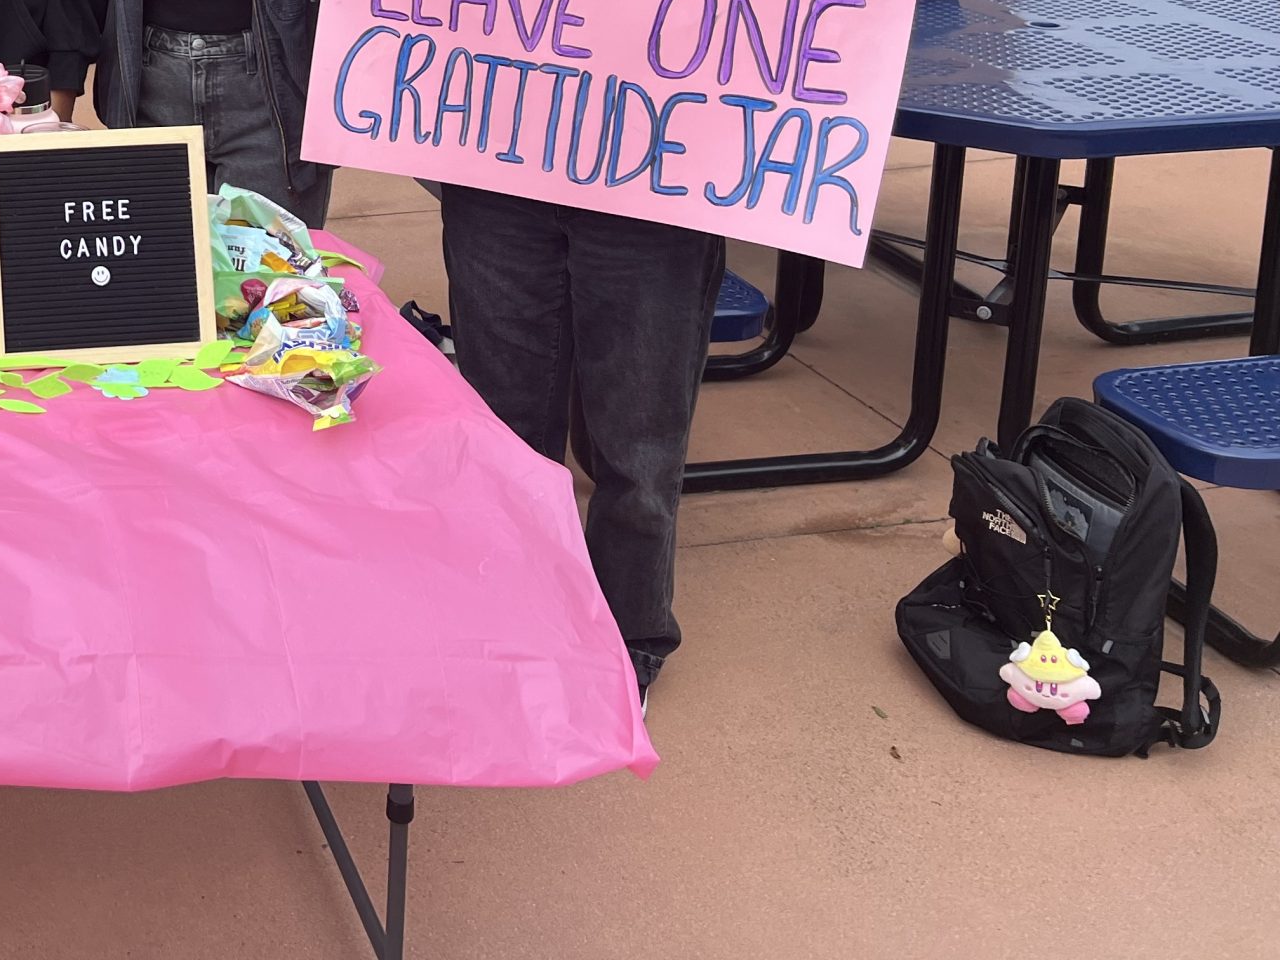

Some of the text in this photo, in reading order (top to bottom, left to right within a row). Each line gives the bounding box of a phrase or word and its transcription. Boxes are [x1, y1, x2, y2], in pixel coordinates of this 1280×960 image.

[333, 25, 870, 236] GRATITUDE JAR
[64, 199, 131, 223] FREE
[60, 235, 142, 259] CANDY
